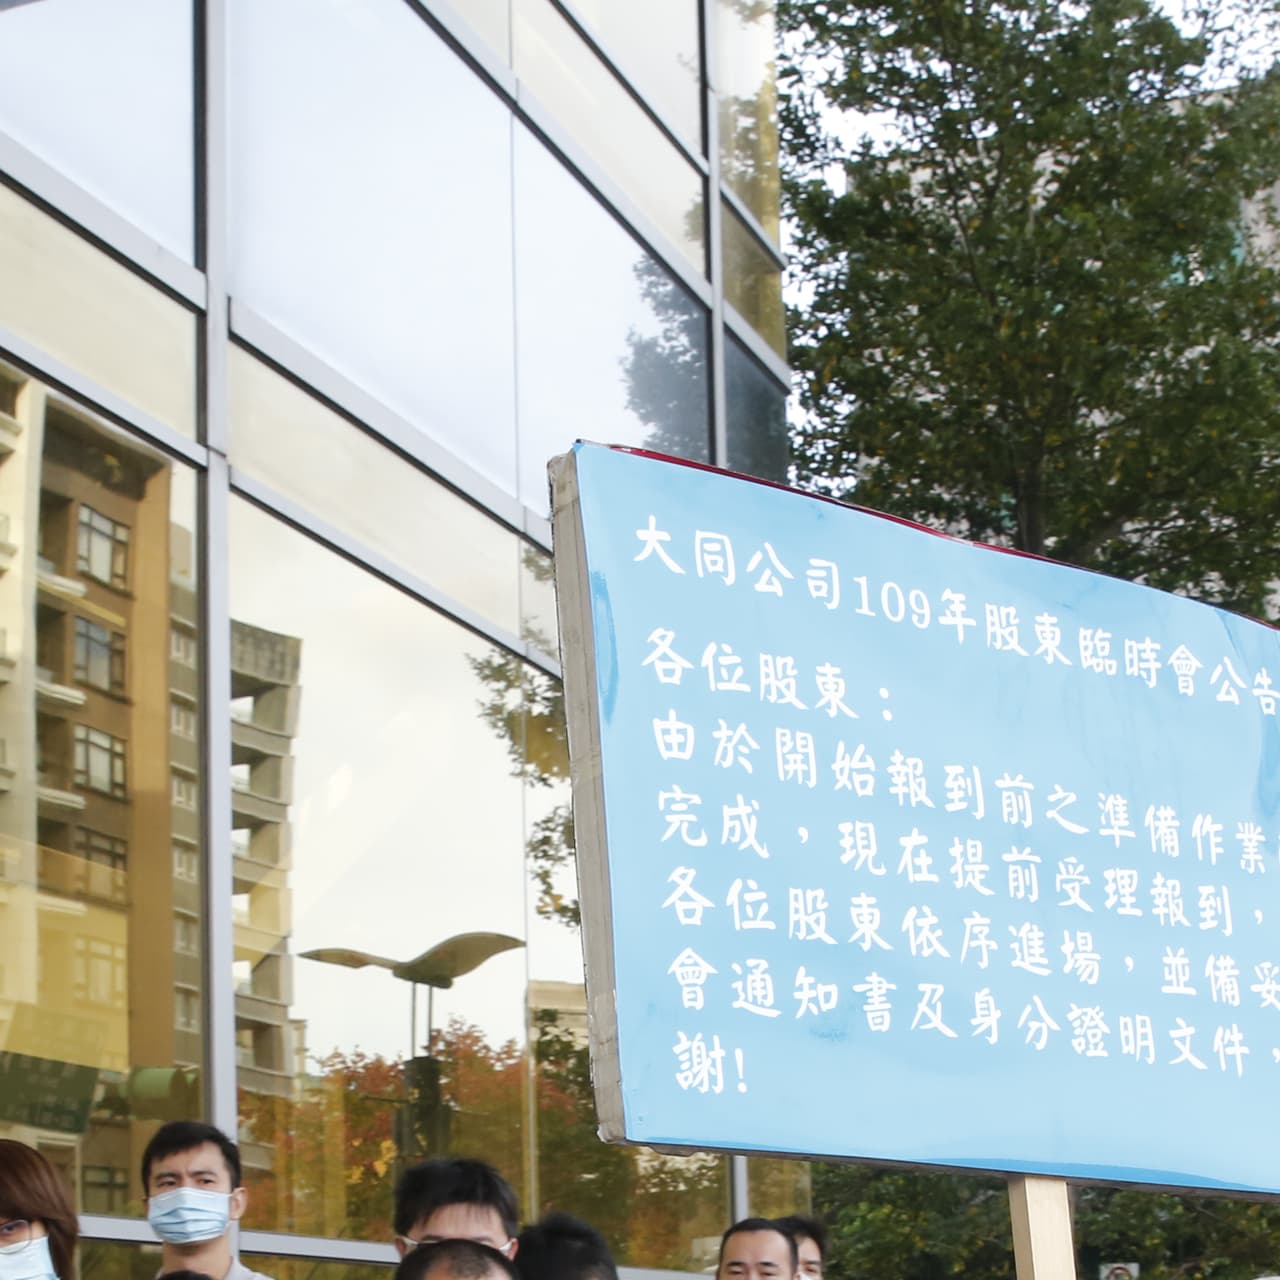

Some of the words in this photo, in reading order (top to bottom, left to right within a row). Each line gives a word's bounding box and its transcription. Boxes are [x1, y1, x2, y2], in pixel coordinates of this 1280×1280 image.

[634, 516, 1280, 716] 大同公司109年股東臨時會公告
[642, 627, 893, 721] 各位股東：
